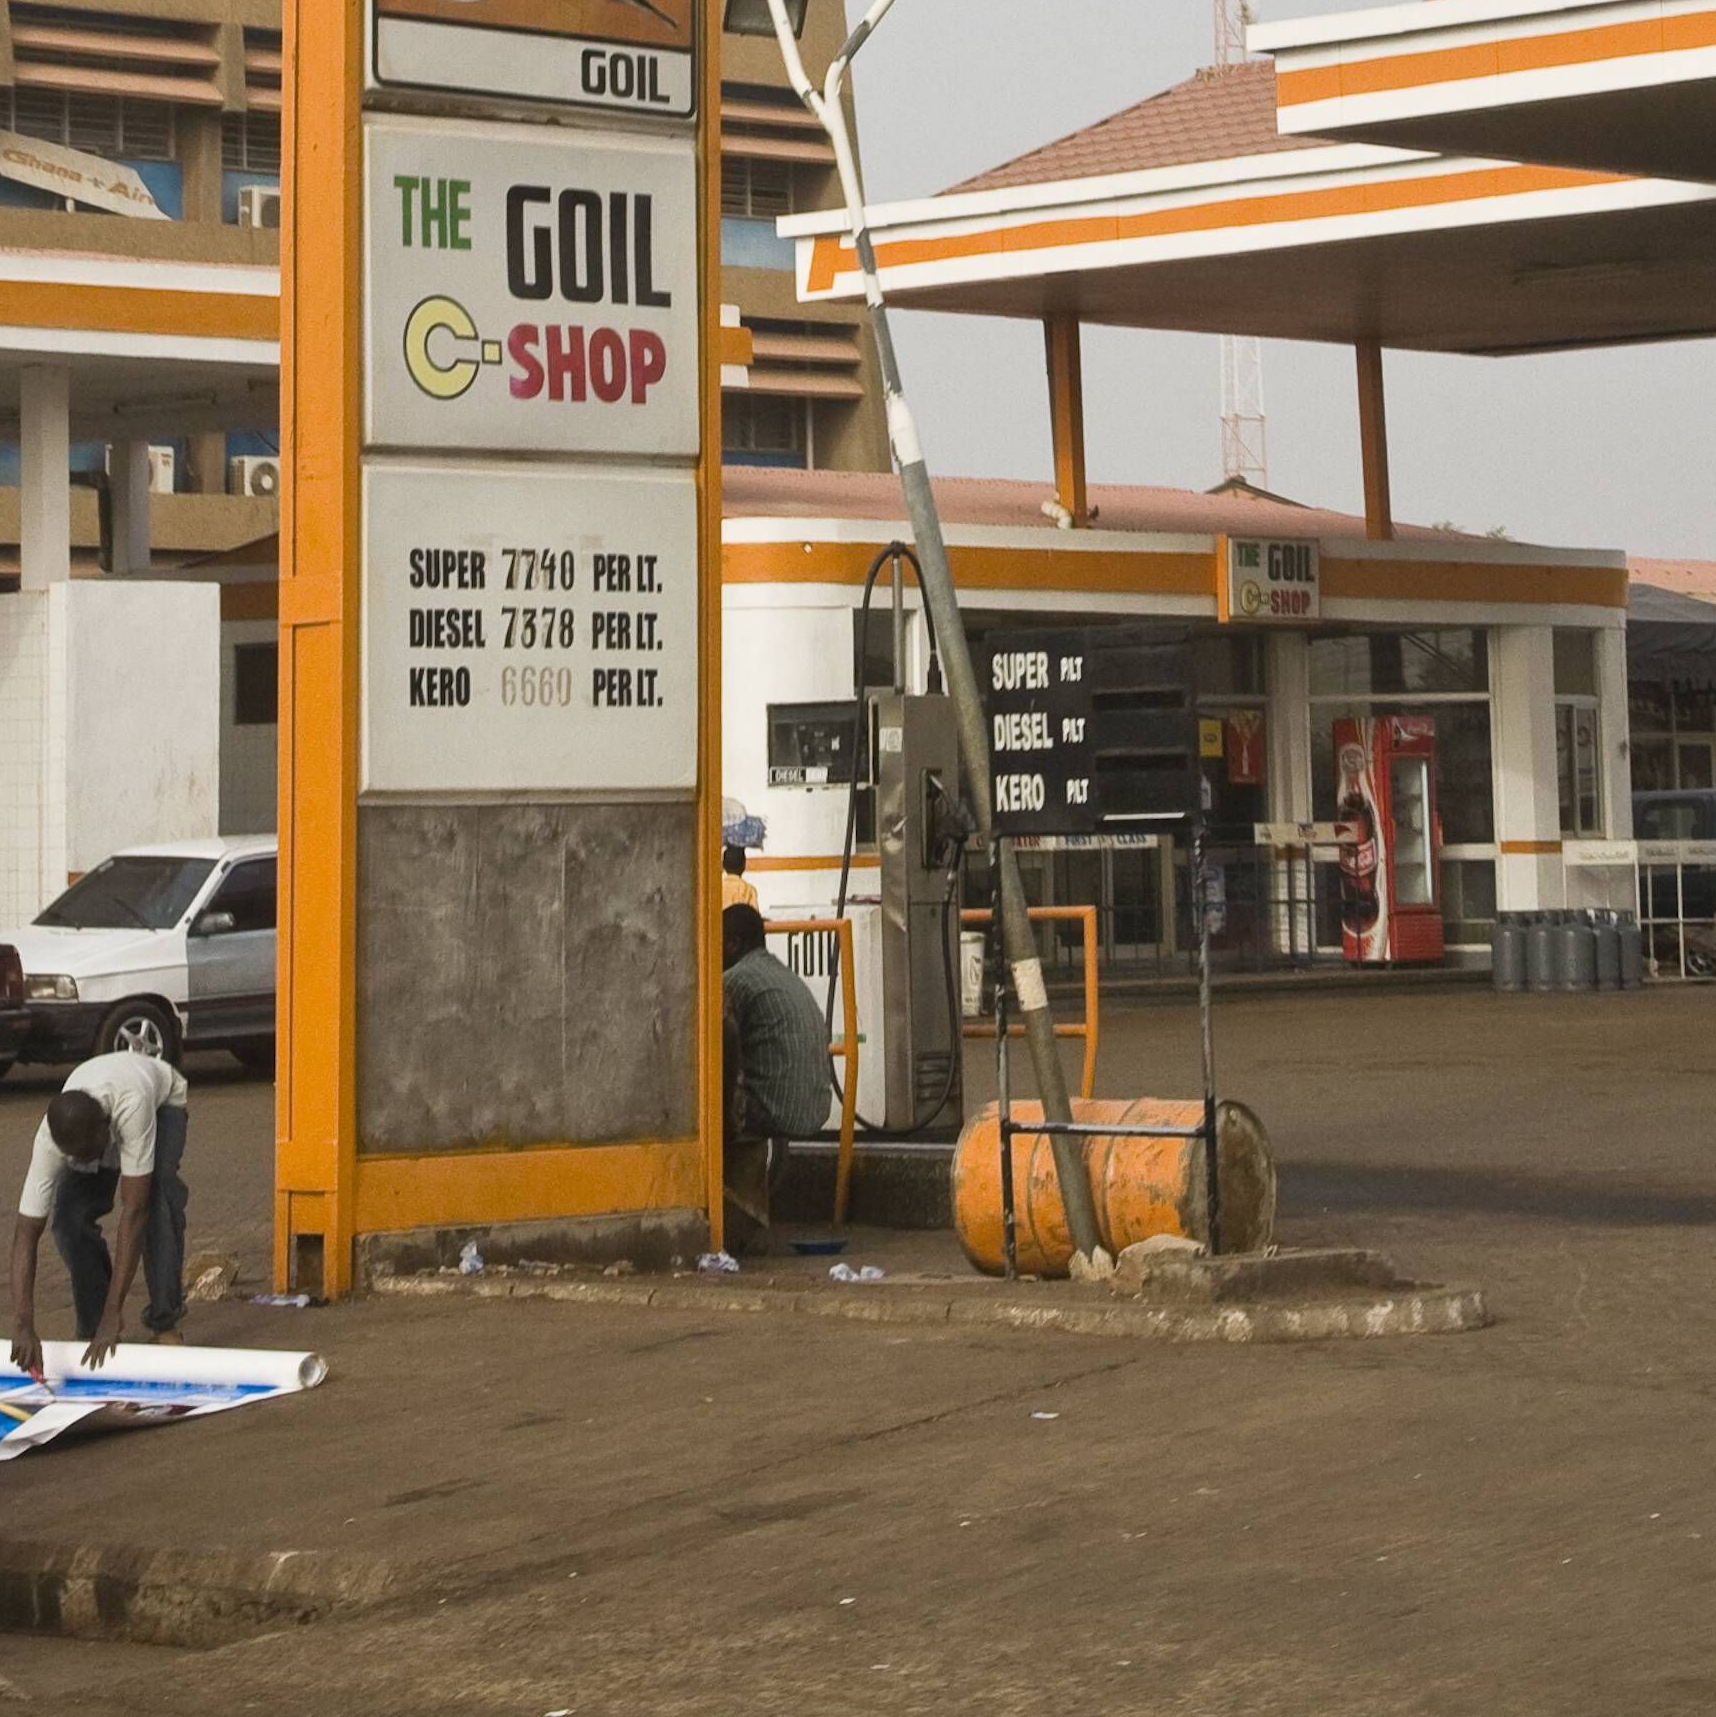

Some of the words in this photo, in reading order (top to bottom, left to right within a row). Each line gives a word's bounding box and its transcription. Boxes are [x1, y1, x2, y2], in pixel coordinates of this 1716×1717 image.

[581, 49, 671, 104] GOIL
[2, 148, 83, 183] Ghana
[393, 175, 472, 250] THE
[506, 185, 672, 308] GOIL
[410, 548, 486, 589] SUPER
[501, 548, 575, 591] 7740
[593, 554, 631, 592] PER
[636, 555, 663, 593] LT.
[1268, 544, 1315, 582] GOIL
[409, 608, 486, 649] DIESEL
[501, 606, 575, 649] 7378
[592, 612, 631, 650] PER
[636, 612, 663, 650] LT.
[410, 667, 471, 707] KERO
[593, 668, 632, 707] PER
[636, 669, 663, 707] LT.
[992, 652, 1049, 690] SUPER
[994, 712, 1054, 751] DIESEL
[996, 774, 1045, 812] KERO
